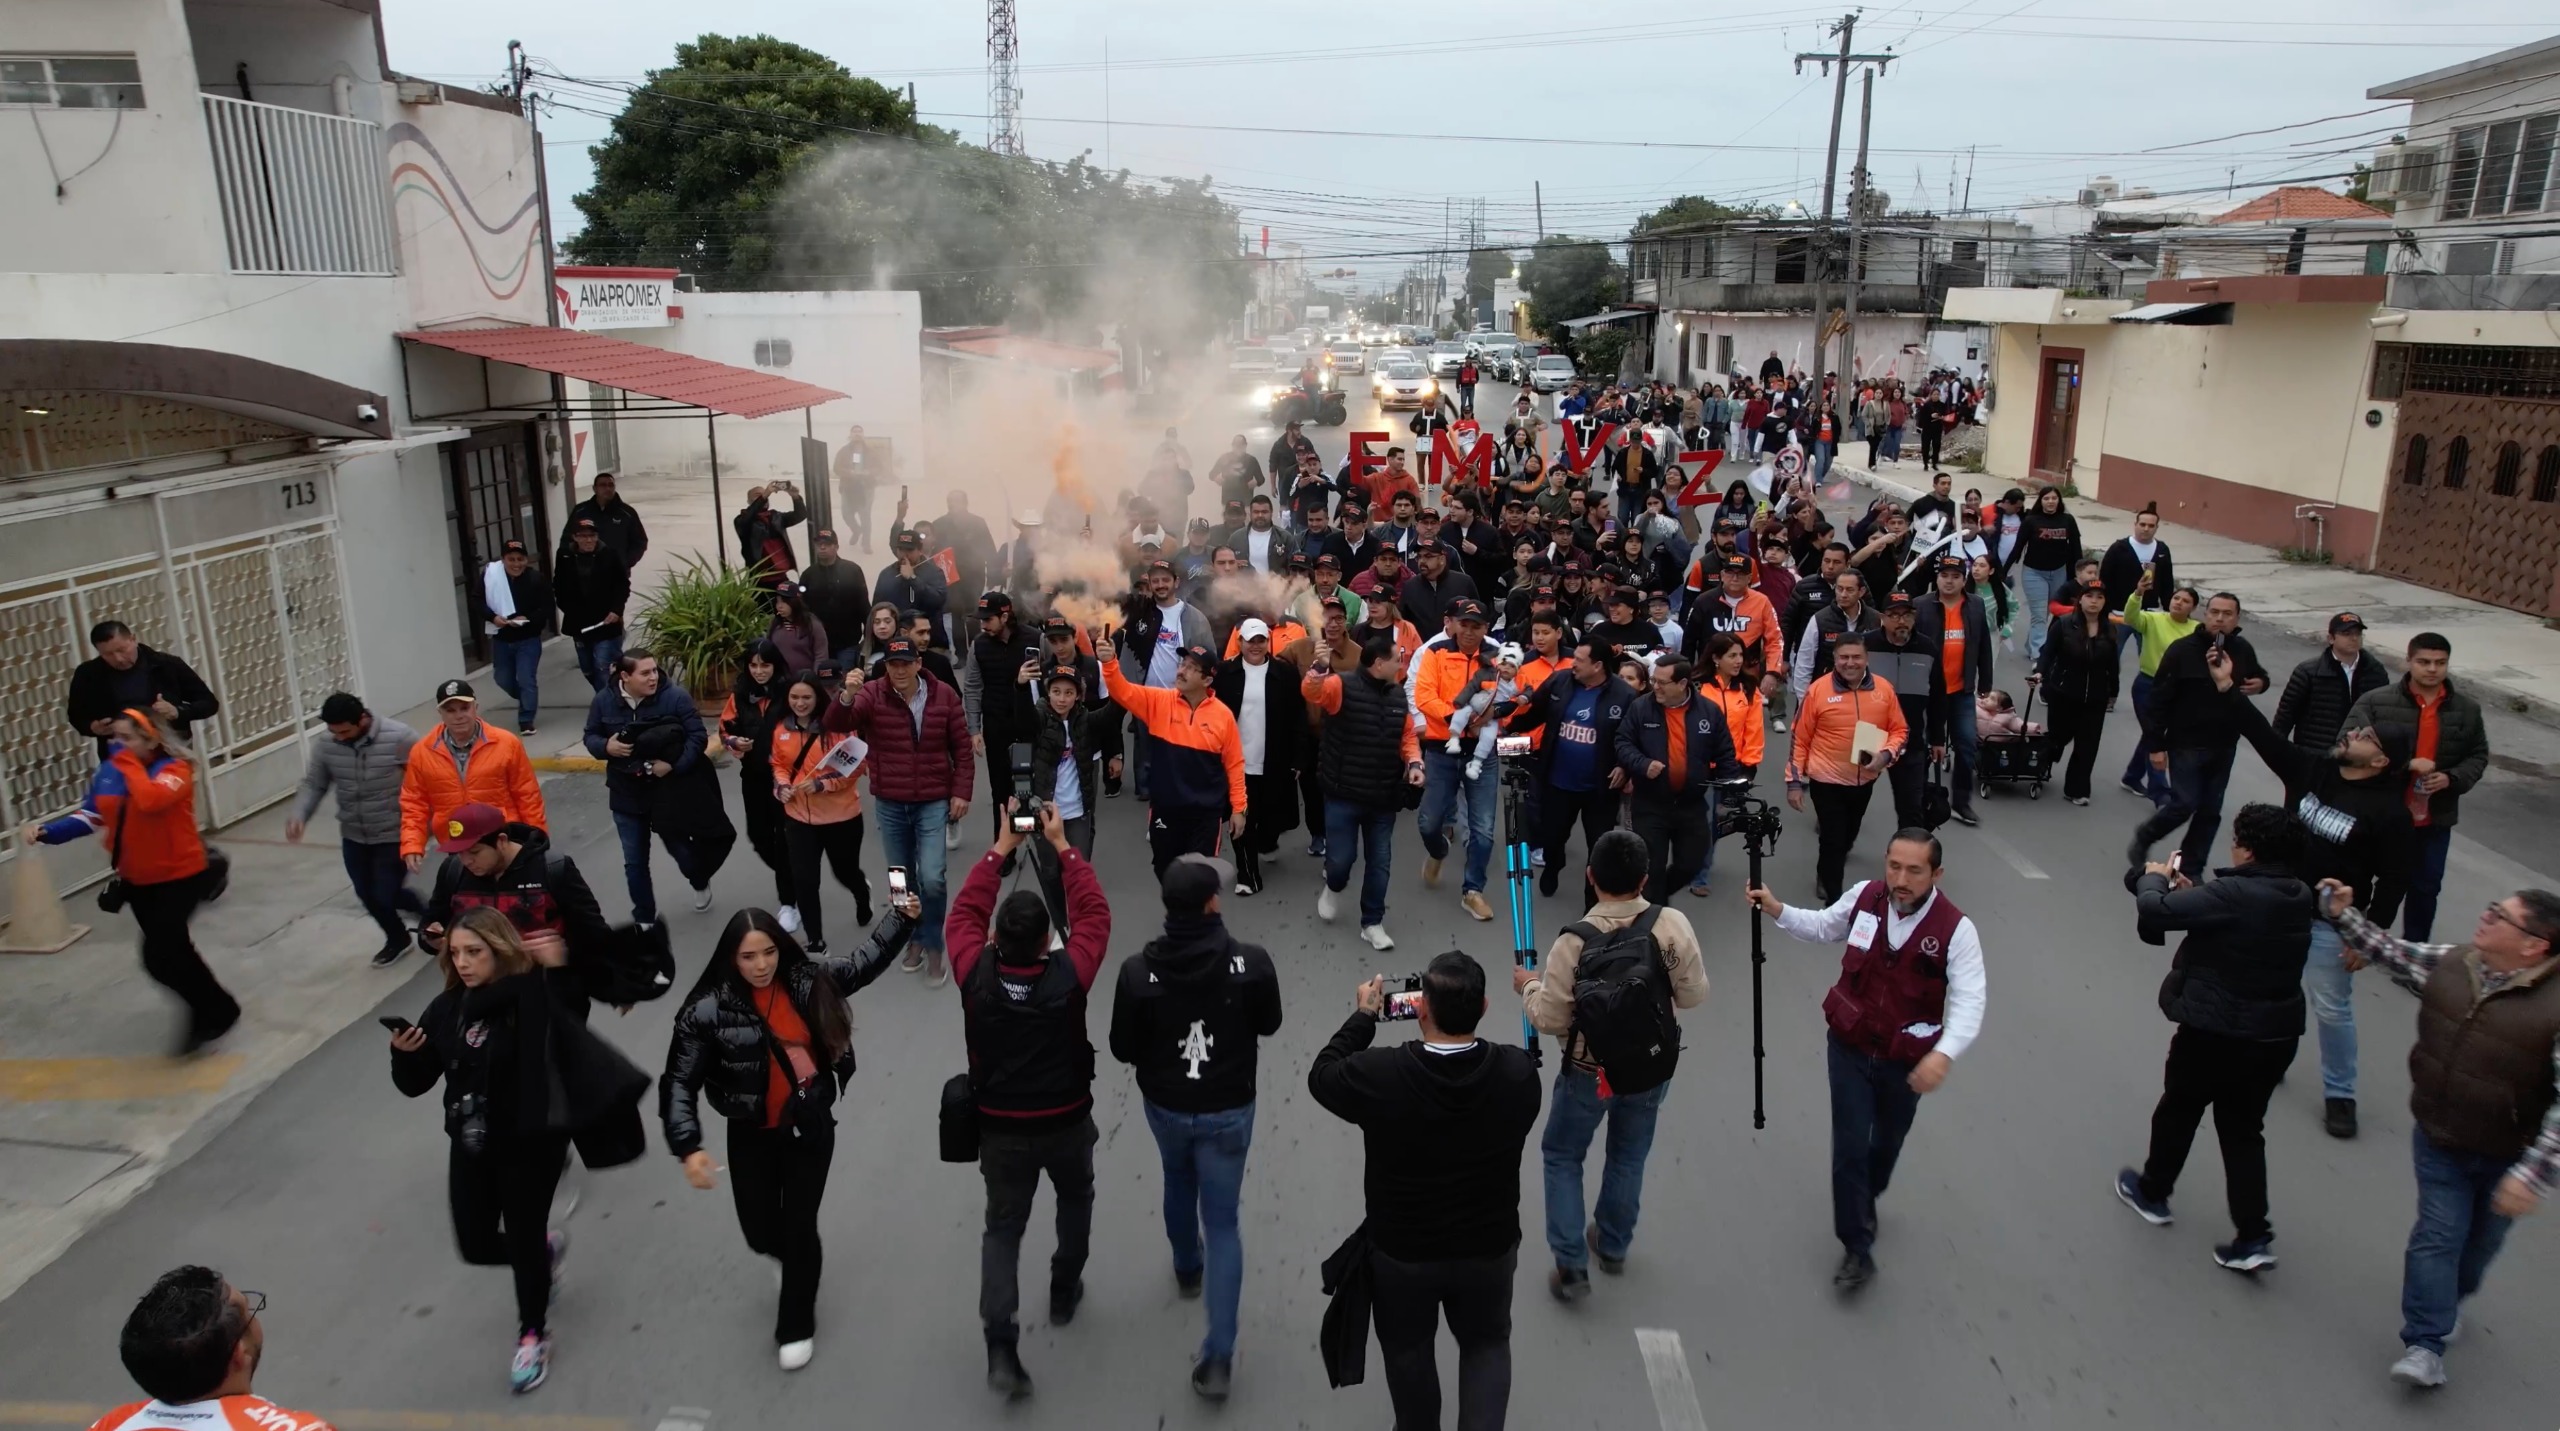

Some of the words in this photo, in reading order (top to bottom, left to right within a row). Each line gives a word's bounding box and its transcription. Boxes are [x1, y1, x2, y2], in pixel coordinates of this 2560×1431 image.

[580, 284, 662, 307] ANAPROMEX
[1430, 429, 1494, 488] M
[1561, 419, 1616, 475] V
[1677, 450, 1724, 505] Z
[281, 481, 316, 509] 713
[1729, 555, 1745, 563] UAT
[1712, 615, 1751, 632] UAT
[1827, 695, 1843, 703] UAT
[1558, 720, 1597, 745] BÚHO
